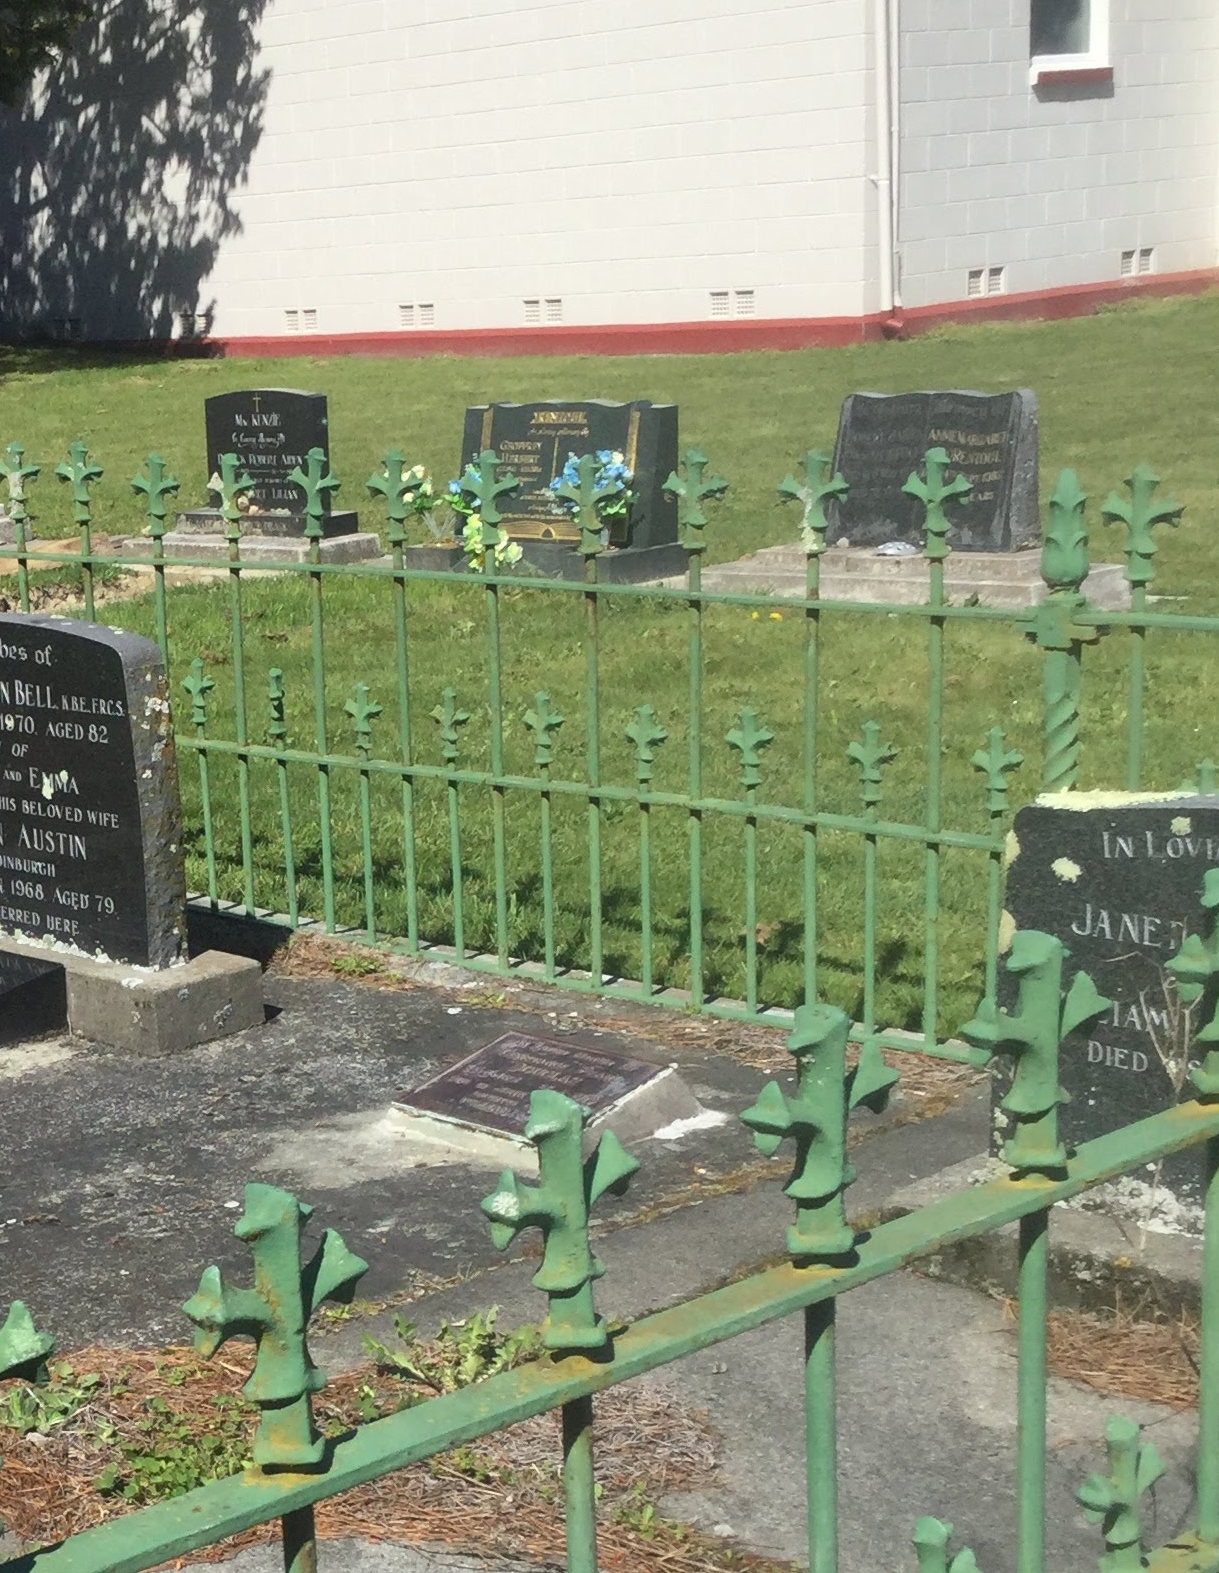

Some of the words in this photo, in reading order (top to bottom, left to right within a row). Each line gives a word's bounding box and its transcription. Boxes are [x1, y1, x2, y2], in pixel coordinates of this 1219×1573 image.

[45, 721, 83, 740] AGED
[88, 724, 109, 744] 82
[11, 743, 29, 758] OF
[3, 769, 22, 782] AND
[22, 800, 82, 823] BELOVED
[87, 810, 120, 829] WIFE
[18, 824, 87, 860] AUSTIN
[1102, 831, 1137, 859] IN
[1146, 830, 1219, 860] LOVI
[52, 887, 89, 910] AGED
[46, 914, 80, 936] HERE
[1088, 1040, 1149, 1072] DIED
